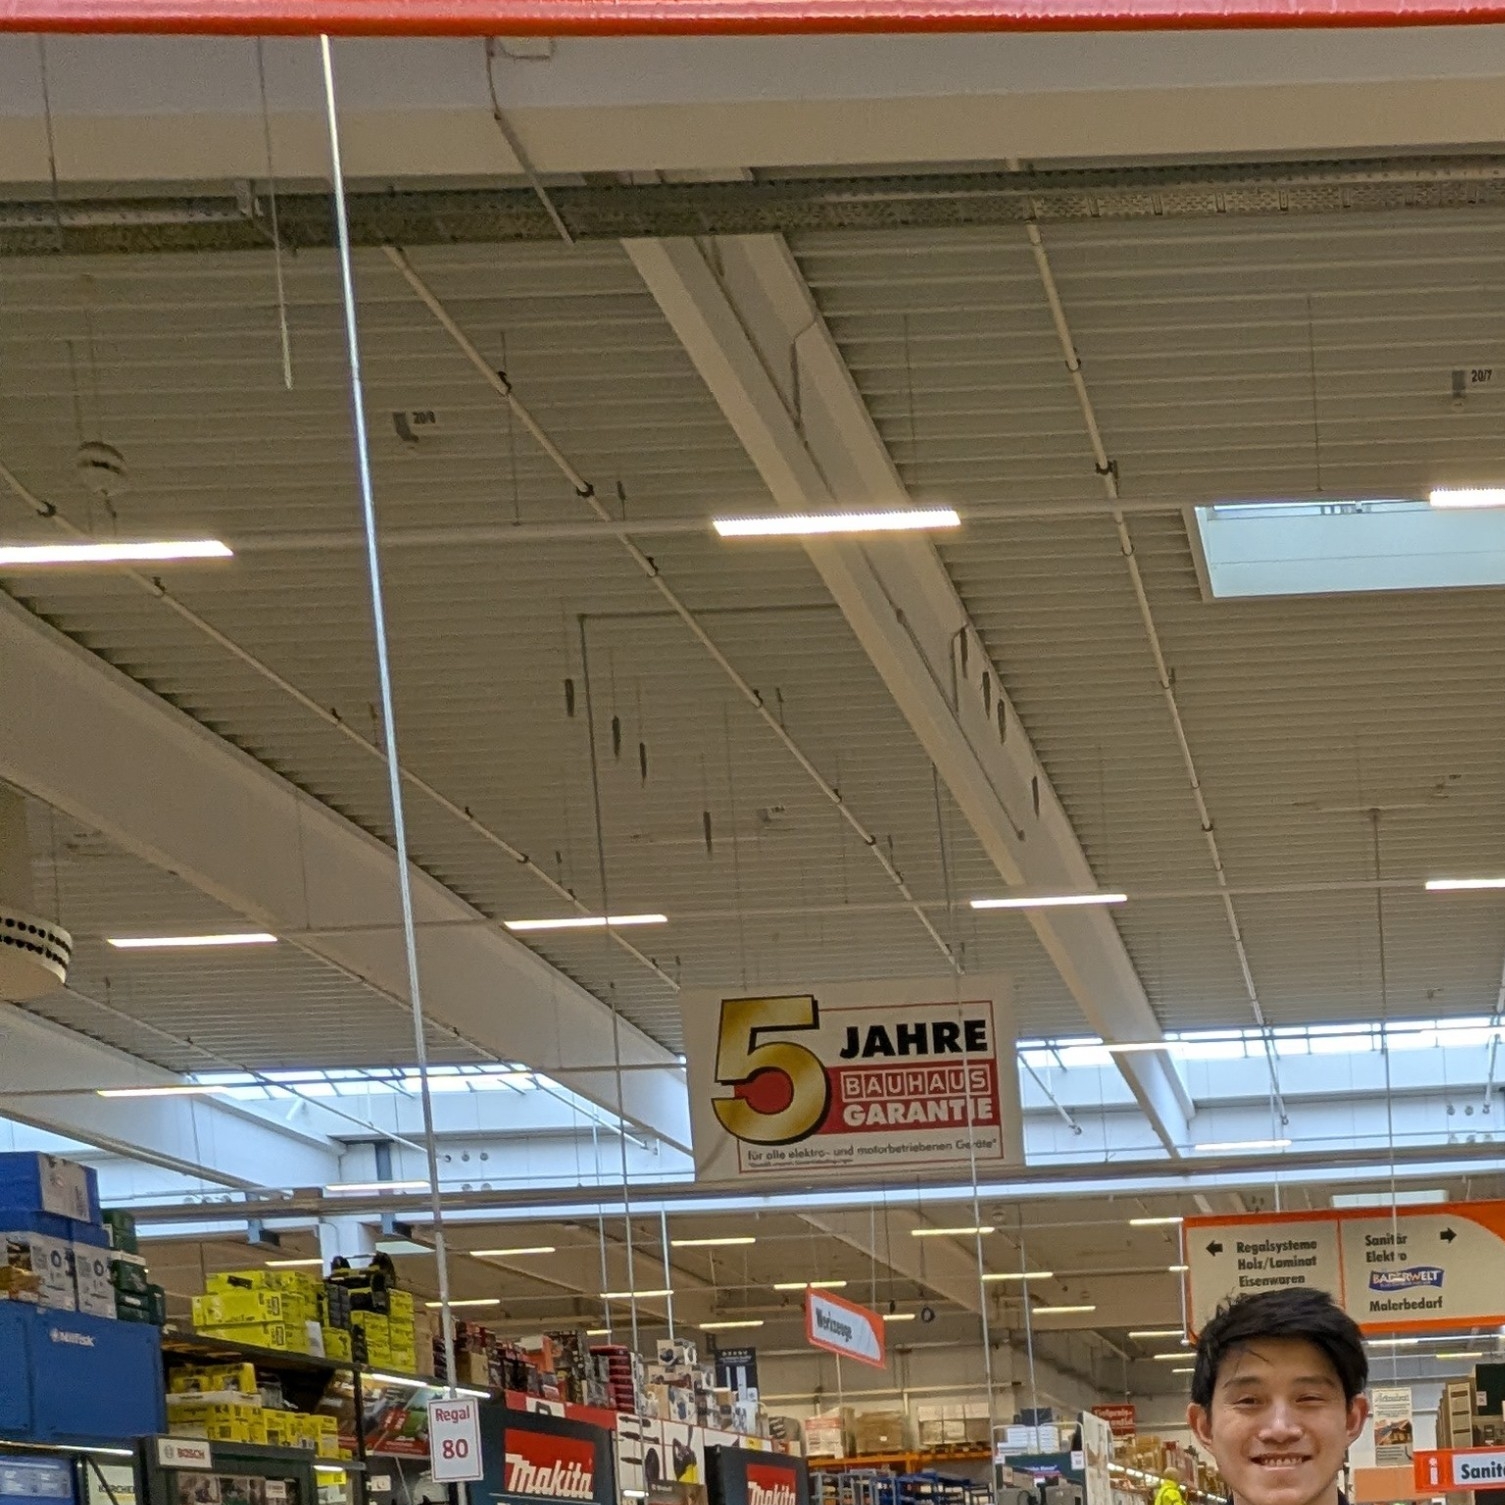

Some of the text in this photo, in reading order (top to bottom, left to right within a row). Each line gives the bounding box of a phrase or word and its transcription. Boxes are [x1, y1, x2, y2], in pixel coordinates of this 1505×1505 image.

[840, 1020, 988, 1059] JAHRE
[711, 994, 831, 1146] 5
[844, 1068, 987, 1098] BAUHAUS
[843, 1098, 993, 1127] GARANTIE
[834, 1146, 854, 1157] und
[1236, 1238, 1318, 1254] Regalsysteme
[1237, 1255, 1317, 1270] Holz/Laminat
[1366, 1250, 1407, 1263] Elekto
[1239, 1272, 1306, 1288] Eisenwaren
[1369, 1296, 1444, 1312] Malerbedarf
[436, 1407, 470, 1424] Regal
[442, 1437, 469, 1461] 80
[505, 1453, 595, 1500] makita
